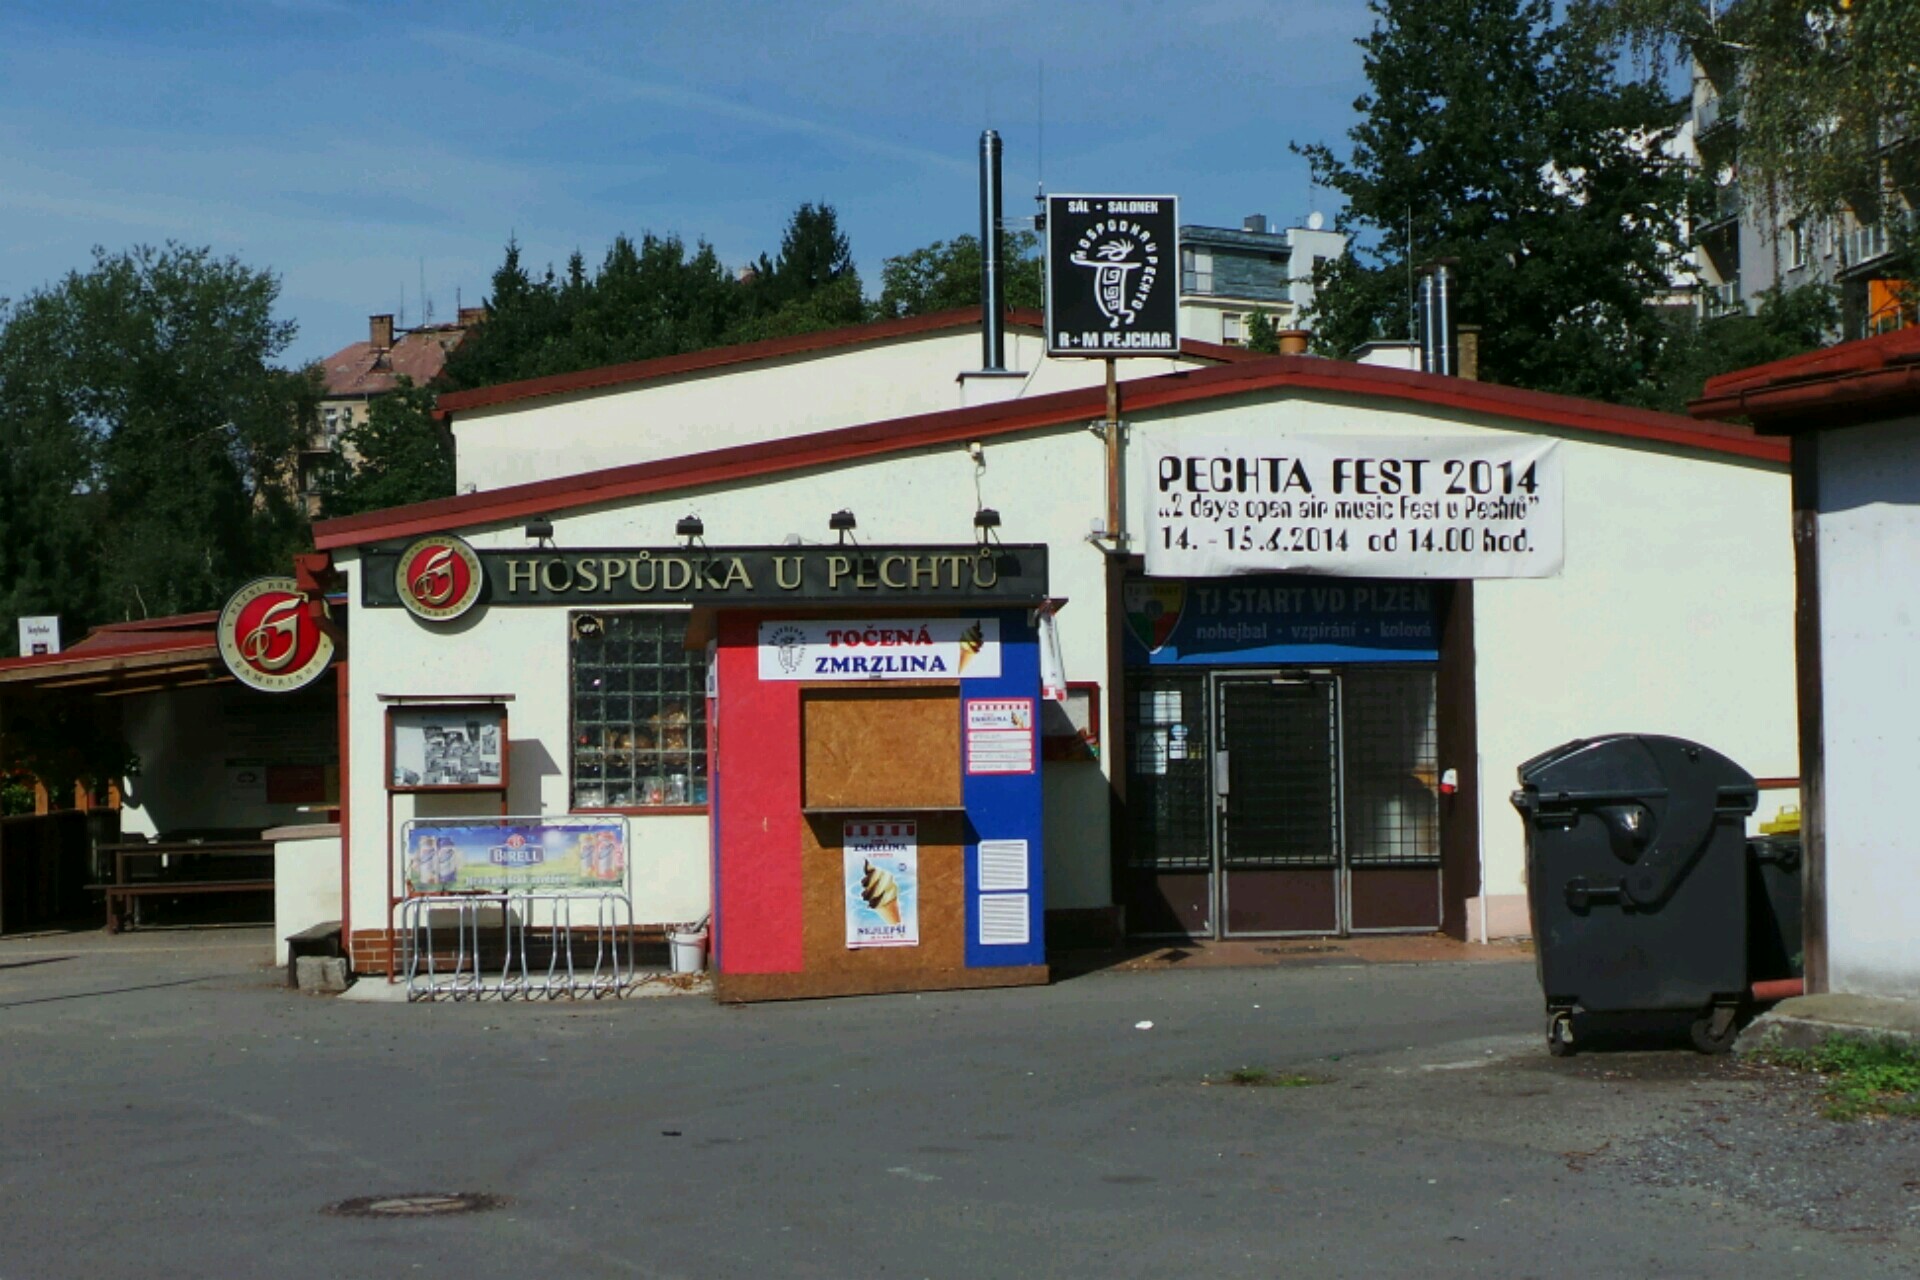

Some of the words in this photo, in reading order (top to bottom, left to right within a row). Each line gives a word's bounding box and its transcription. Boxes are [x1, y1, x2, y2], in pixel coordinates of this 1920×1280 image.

[1068, 200, 1090, 213] SÁL
[1107, 201, 1159, 214] SALONEK
[1103, 331, 1172, 348] PEJCHAR
[1159, 456, 1312, 494] PECHTA
[1332, 458, 1431, 495] FEST
[1443, 459, 1539, 495] 2014
[1190, 493, 1239, 523] days
[1245, 500, 1292, 523] open
[1299, 494, 1328, 519] air
[1334, 495, 1394, 520] music
[1399, 495, 1440, 520] Fest
[1162, 525, 1199, 550] 14.
[1368, 527, 1398, 552] od
[1408, 527, 1475, 552] 14.00
[1483, 527, 1535, 552] hod.
[505, 550, 754, 592] HOSPŮDKA
[772, 556, 805, 589] U
[825, 547, 998, 589] PECHTŮ
[1196, 588, 1220, 614] TJ
[1228, 587, 1306, 613] START
[826, 623, 934, 647] TOČENÁ
[1197, 622, 1268, 642] nohejbal
[1380, 619, 1431, 638] kolová
[815, 655, 947, 673] ZMRZLINA
